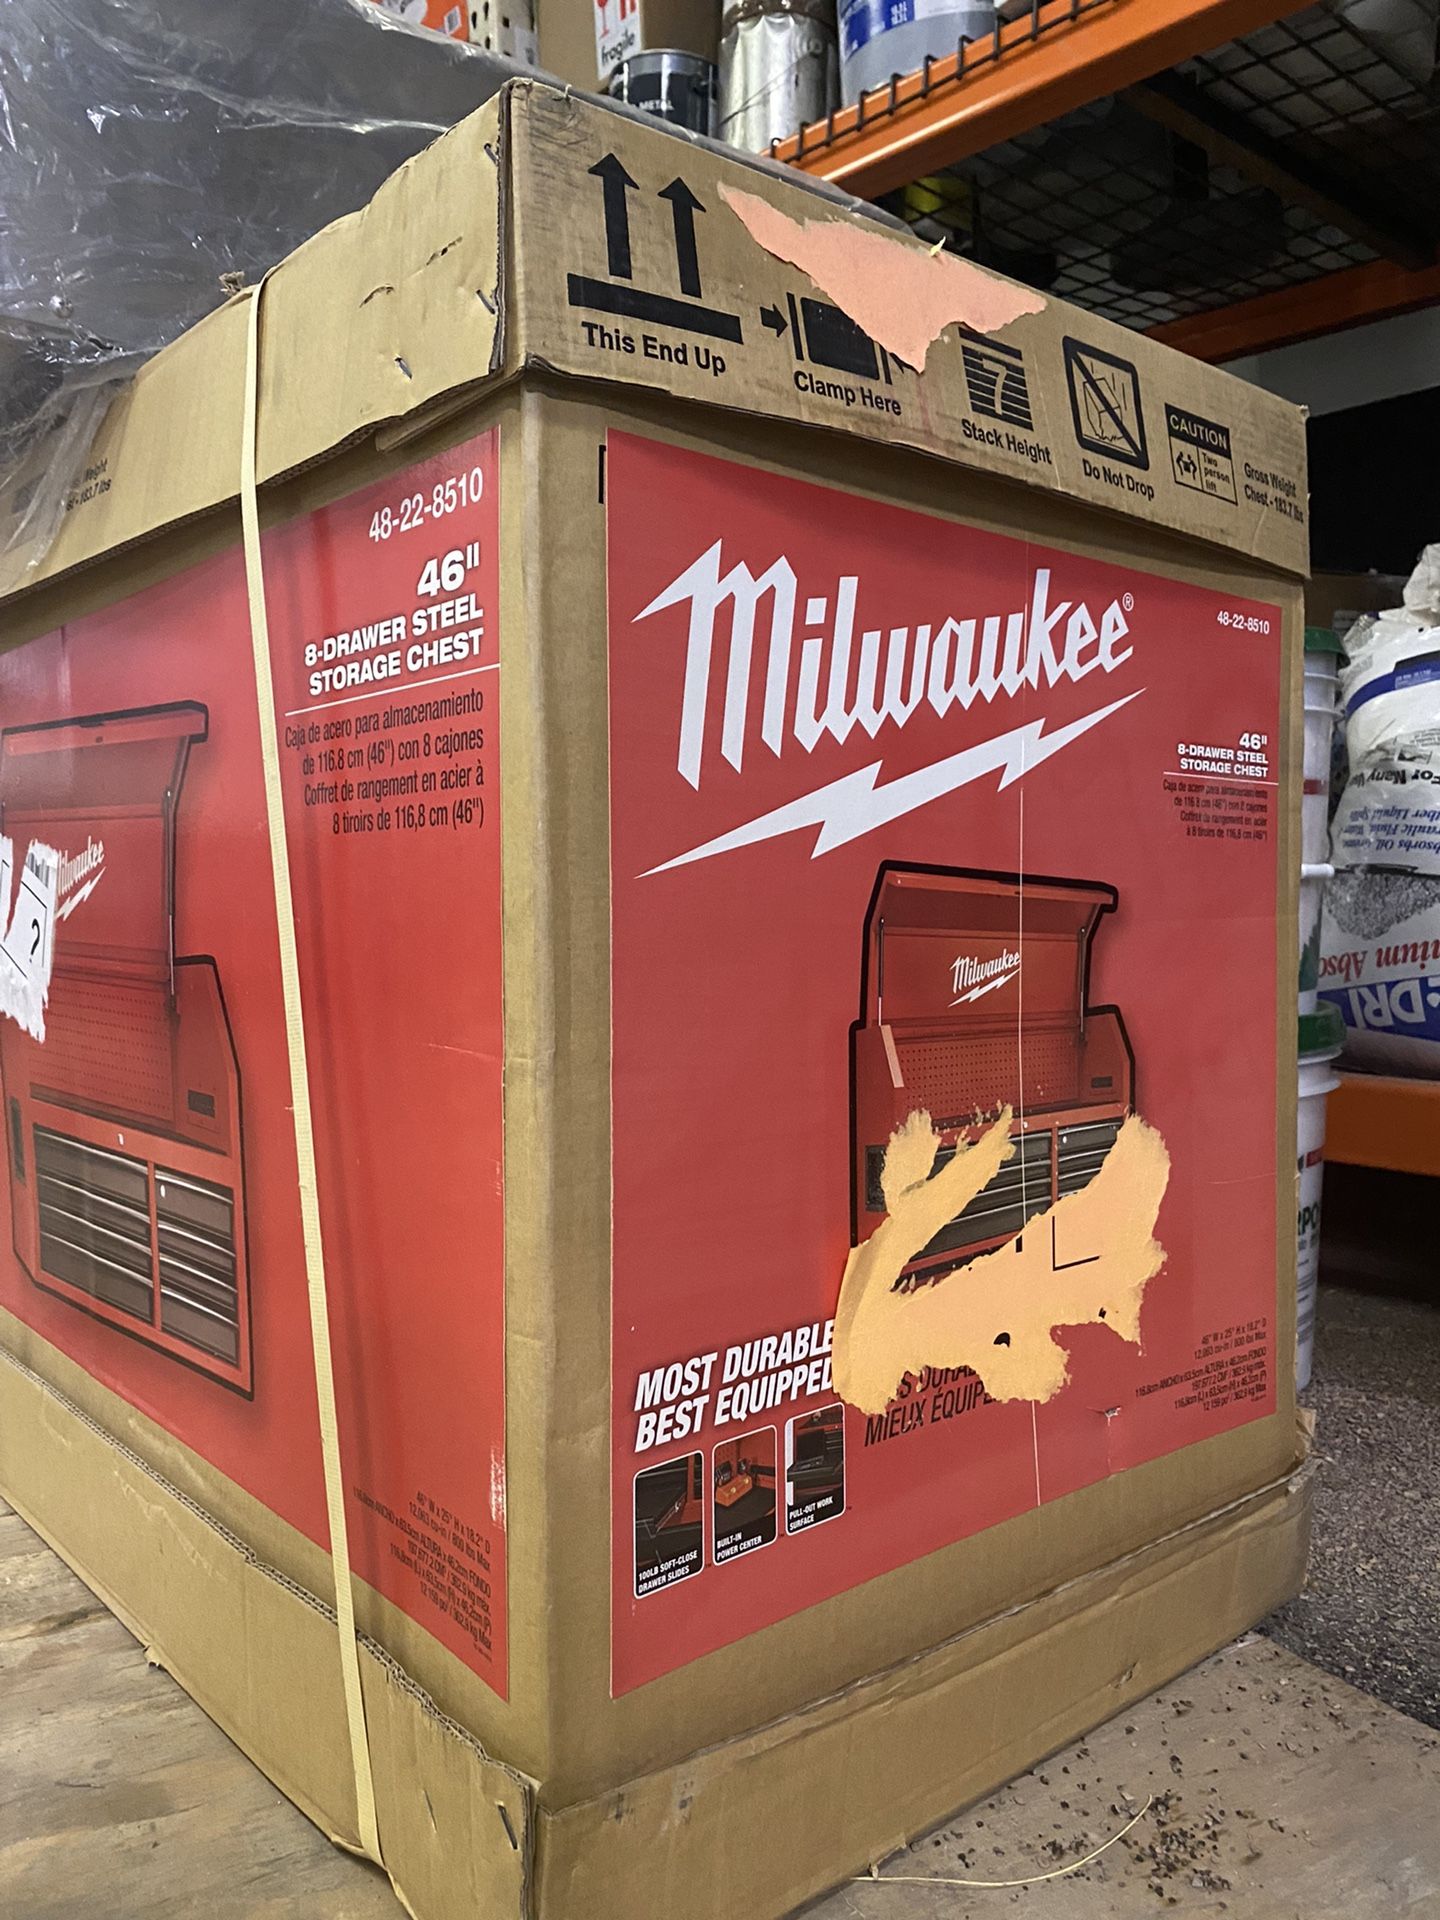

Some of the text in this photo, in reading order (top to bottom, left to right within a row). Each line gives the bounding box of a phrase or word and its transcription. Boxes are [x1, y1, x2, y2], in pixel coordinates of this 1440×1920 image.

[581, 321, 726, 376] This End Up
[793, 370, 902, 416] Clamp Here
[961, 418, 1052, 465] Stack Height
[1169, 414, 1228, 450] CAUTION
[1201, 452, 1218, 467] Two
[1204, 467, 1231, 485] person
[1082, 458, 1155, 501] Do Not Drop
[1205, 479, 1217, 493] lift
[1244, 462, 1297, 498] Gross Weight
[1244, 484, 1269, 507] Chest
[368, 467, 483, 542] 48-22-8510
[416, 542, 480, 597] 46"
[304, 593, 484, 667] 8-DRAWER STEEL
[1217, 610, 1270, 635] 48-22-8510
[309, 627, 484, 696] STORAGE CHEST
[285, 687, 484, 751] Caja de acero para almacenamiento
[303, 754, 315, 776] de
[318, 748, 345, 773] 116.8
[347, 748, 364, 769] cm
[399, 740, 419, 761] con
[423, 732, 430, 757] 8
[435, 728, 484, 759] cajones
[1177, 743, 1269, 764] 8-DRAWER STEEL
[1239, 733, 1268, 750] 46"
[304, 759, 484, 806] Coffret de rangement en acier à
[1180, 758, 1268, 778] STORAGE CHEST
[333, 812, 340, 835] 8
[342, 809, 374, 834] tiroirs
[377, 807, 391, 831] de
[394, 803, 426, 832] 116,8
[429, 805, 448, 827] cm
[58, 835, 104, 897] ilwaukee
[29, 919, 40, 963] ?
[950, 949, 1020, 994] Milwaukee
[634, 1319, 834, 1412] MOST DURABLE
[634, 1393, 711, 1453] BEST
[864, 1399, 927, 1447] MIEUX
[789, 1496, 834, 1520] PULL-OUT WORK
[789, 1515, 814, 1531] SURFACE
[716, 1532, 742, 1549] BUILT-IN
[716, 1535, 762, 1561] POWER CENTER
[638, 1550, 698, 1581] 100LB SOFT-CLOSE
[638, 1565, 690, 1594] DRAWER SLIDES
